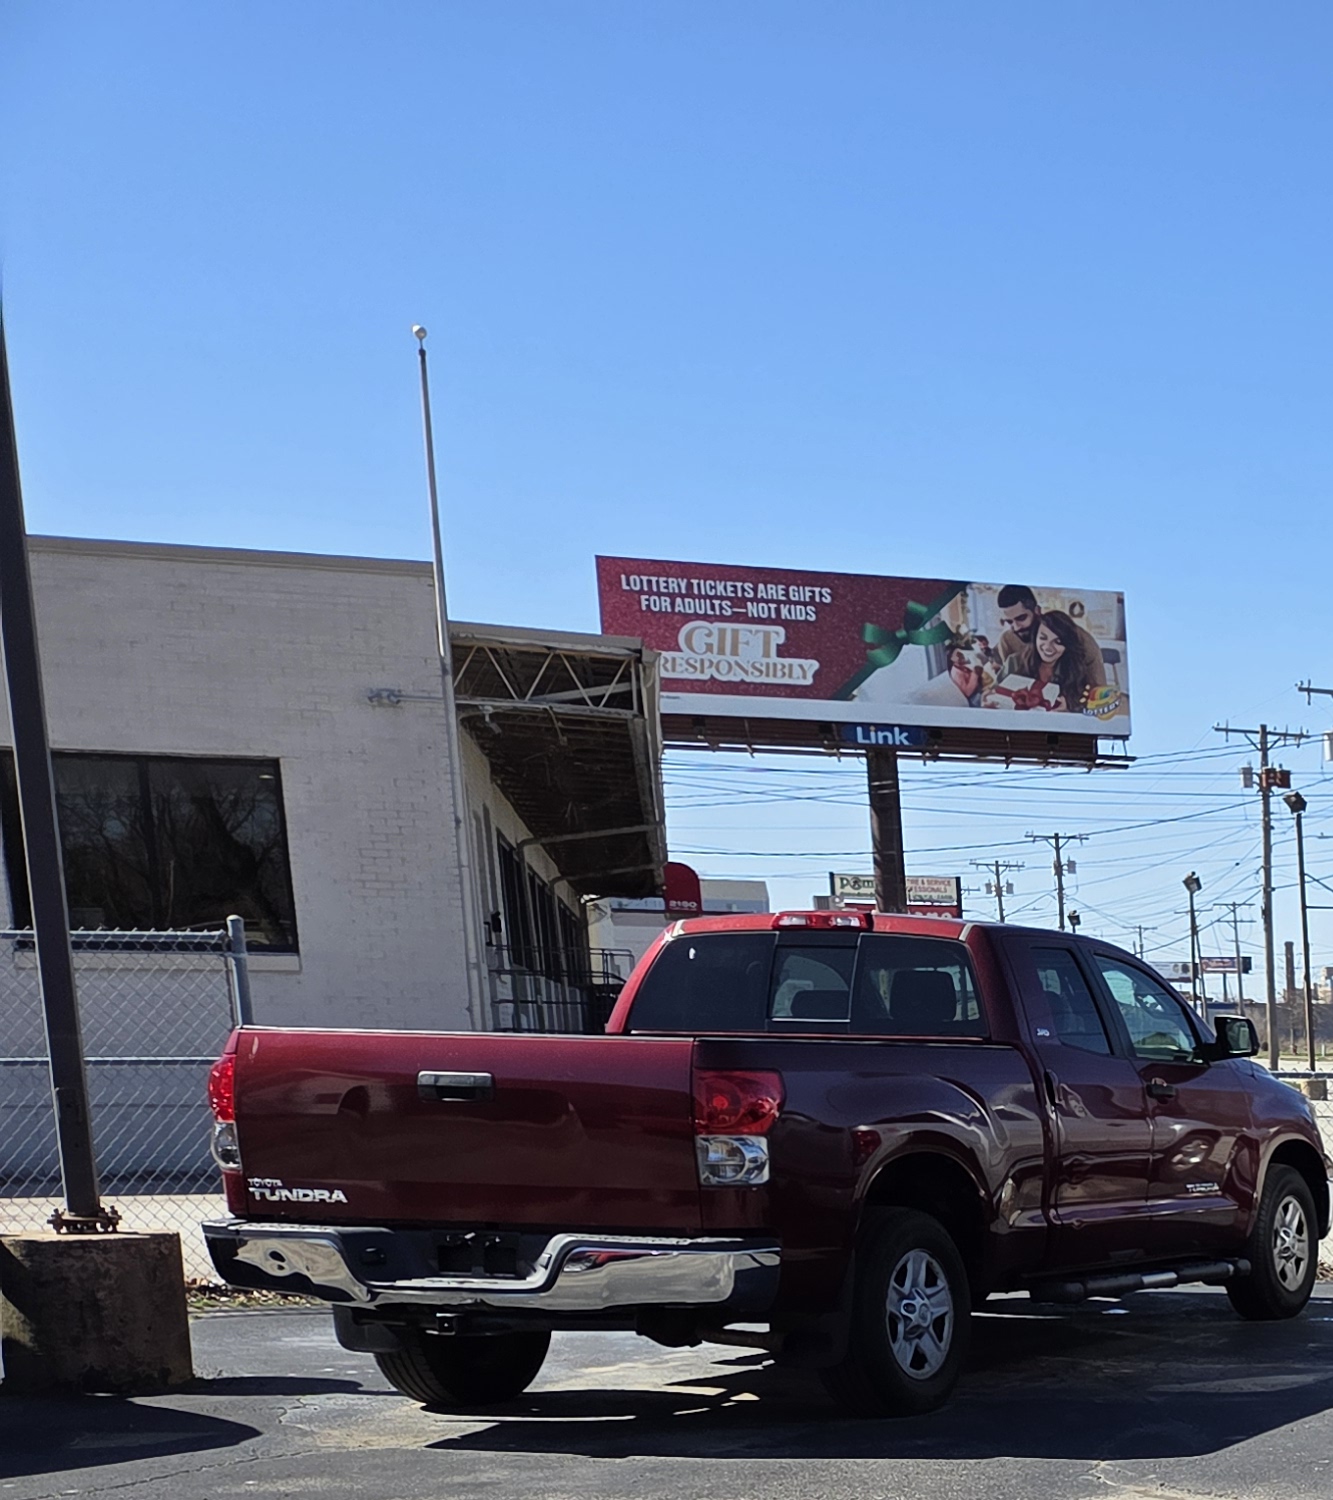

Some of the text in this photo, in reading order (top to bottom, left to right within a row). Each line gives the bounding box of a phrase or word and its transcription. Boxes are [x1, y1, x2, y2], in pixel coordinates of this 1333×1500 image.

[620, 574, 832, 604] LOTTERY TICKETS ARE GIFTS
[640, 595, 671, 613] FOR
[780, 605, 816, 621] KIDS
[684, 626, 780, 659] GIFT
[661, 656, 814, 680] RESPONSIBLY
[1083, 700, 1120, 715] LOTTERY
[856, 726, 910, 746] Link
[840, 876, 874, 891] Pom
[247, 1178, 283, 1187] TOYOTA
[248, 1187, 348, 1203] TUNDRA
